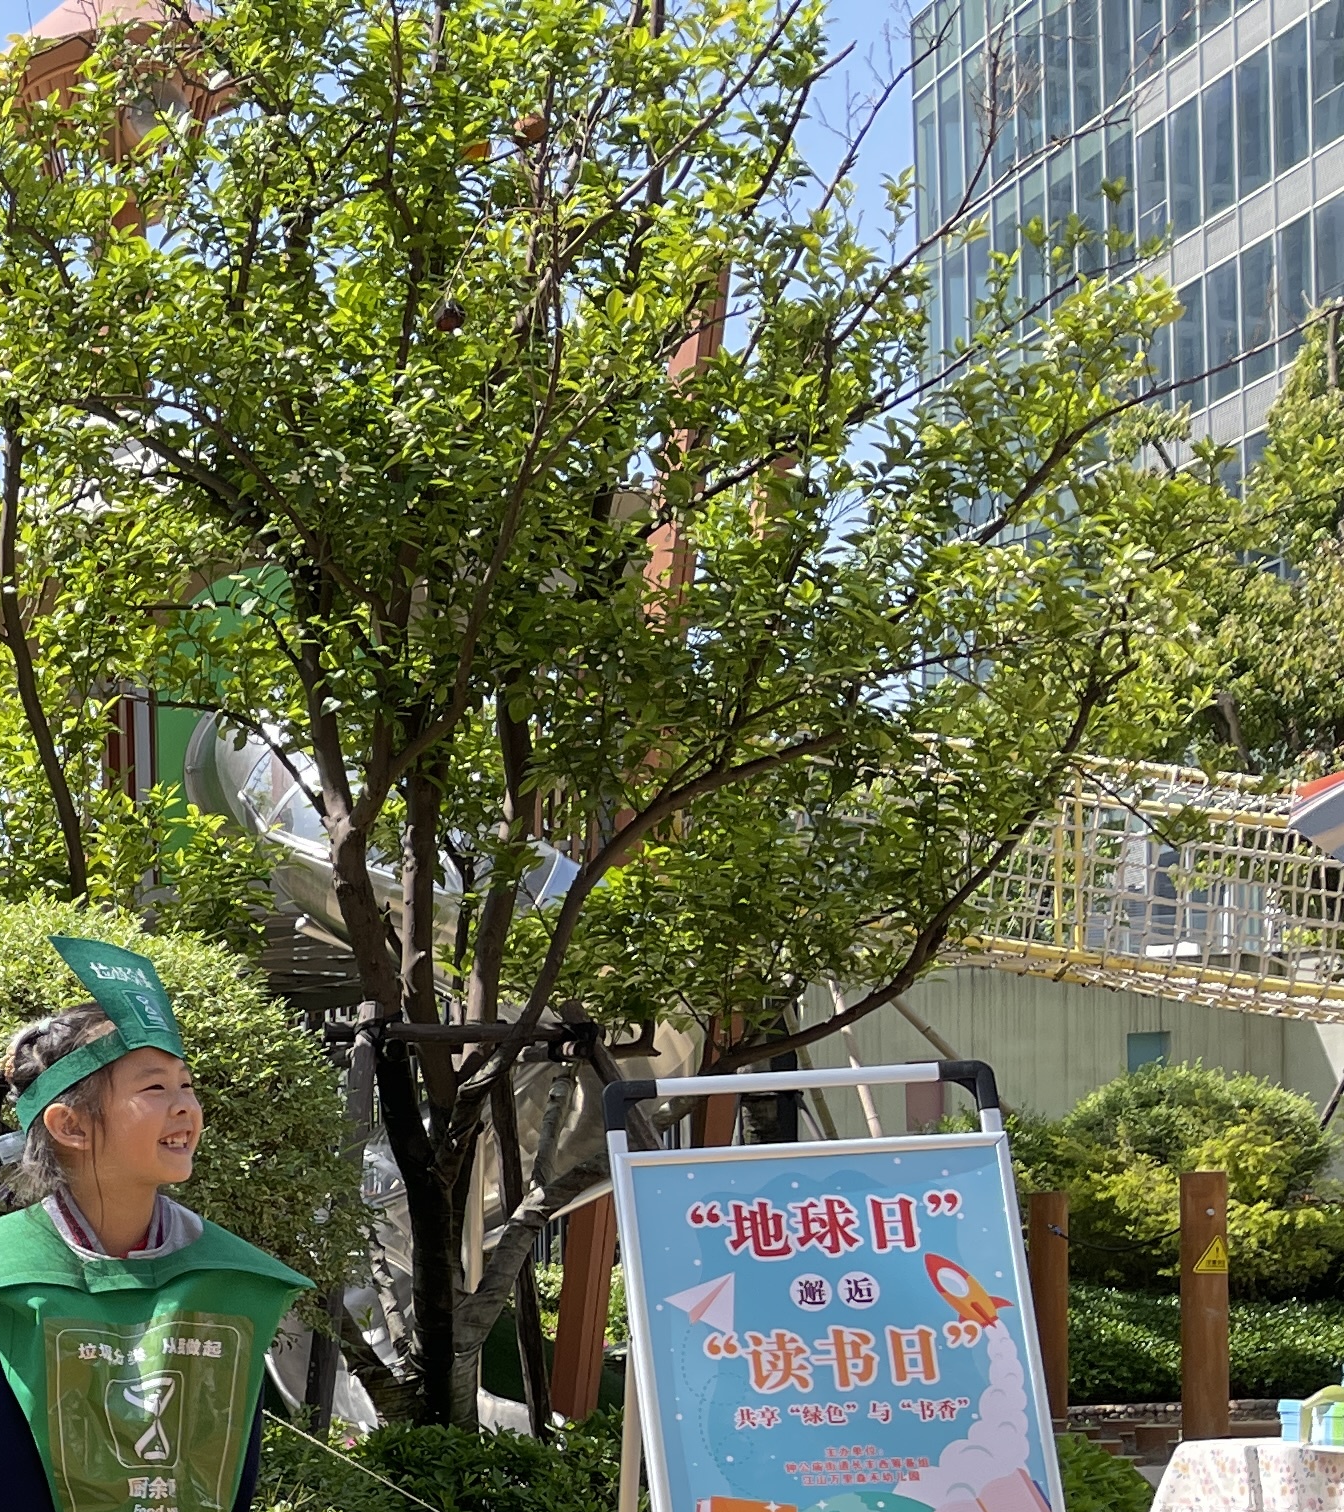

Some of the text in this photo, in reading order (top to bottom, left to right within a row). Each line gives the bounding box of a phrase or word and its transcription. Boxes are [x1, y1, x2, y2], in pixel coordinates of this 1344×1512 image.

[690, 1193, 960, 1257] “地球日”
[707, 1321, 981, 1391] “读书日”
